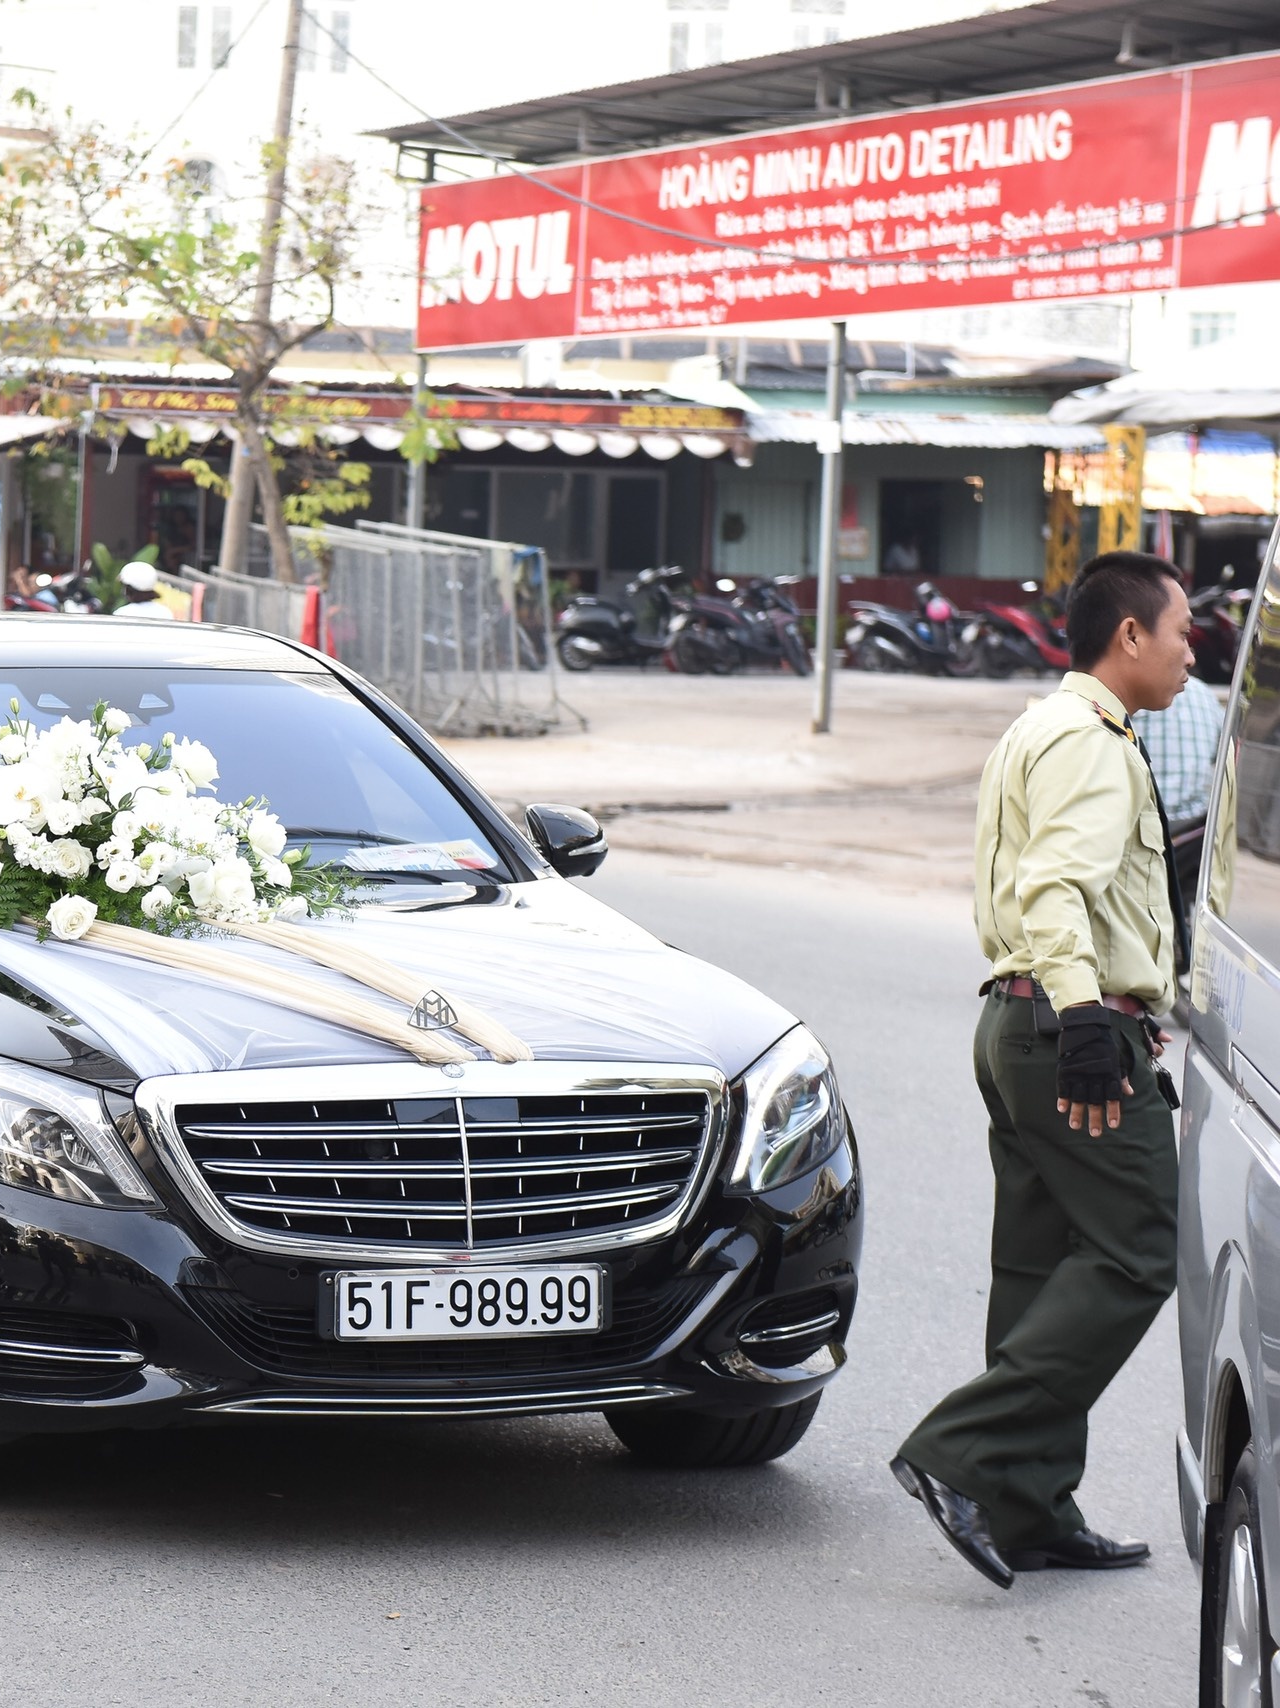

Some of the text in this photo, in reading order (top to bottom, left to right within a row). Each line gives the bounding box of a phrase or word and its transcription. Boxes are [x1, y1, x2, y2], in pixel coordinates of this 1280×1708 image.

[659, 109, 1071, 210] HOÀNG MINH AUTO DETAILING
[420, 209, 575, 309] MOTUL
[348, 1275, 591, 1330] 51F-989.99
